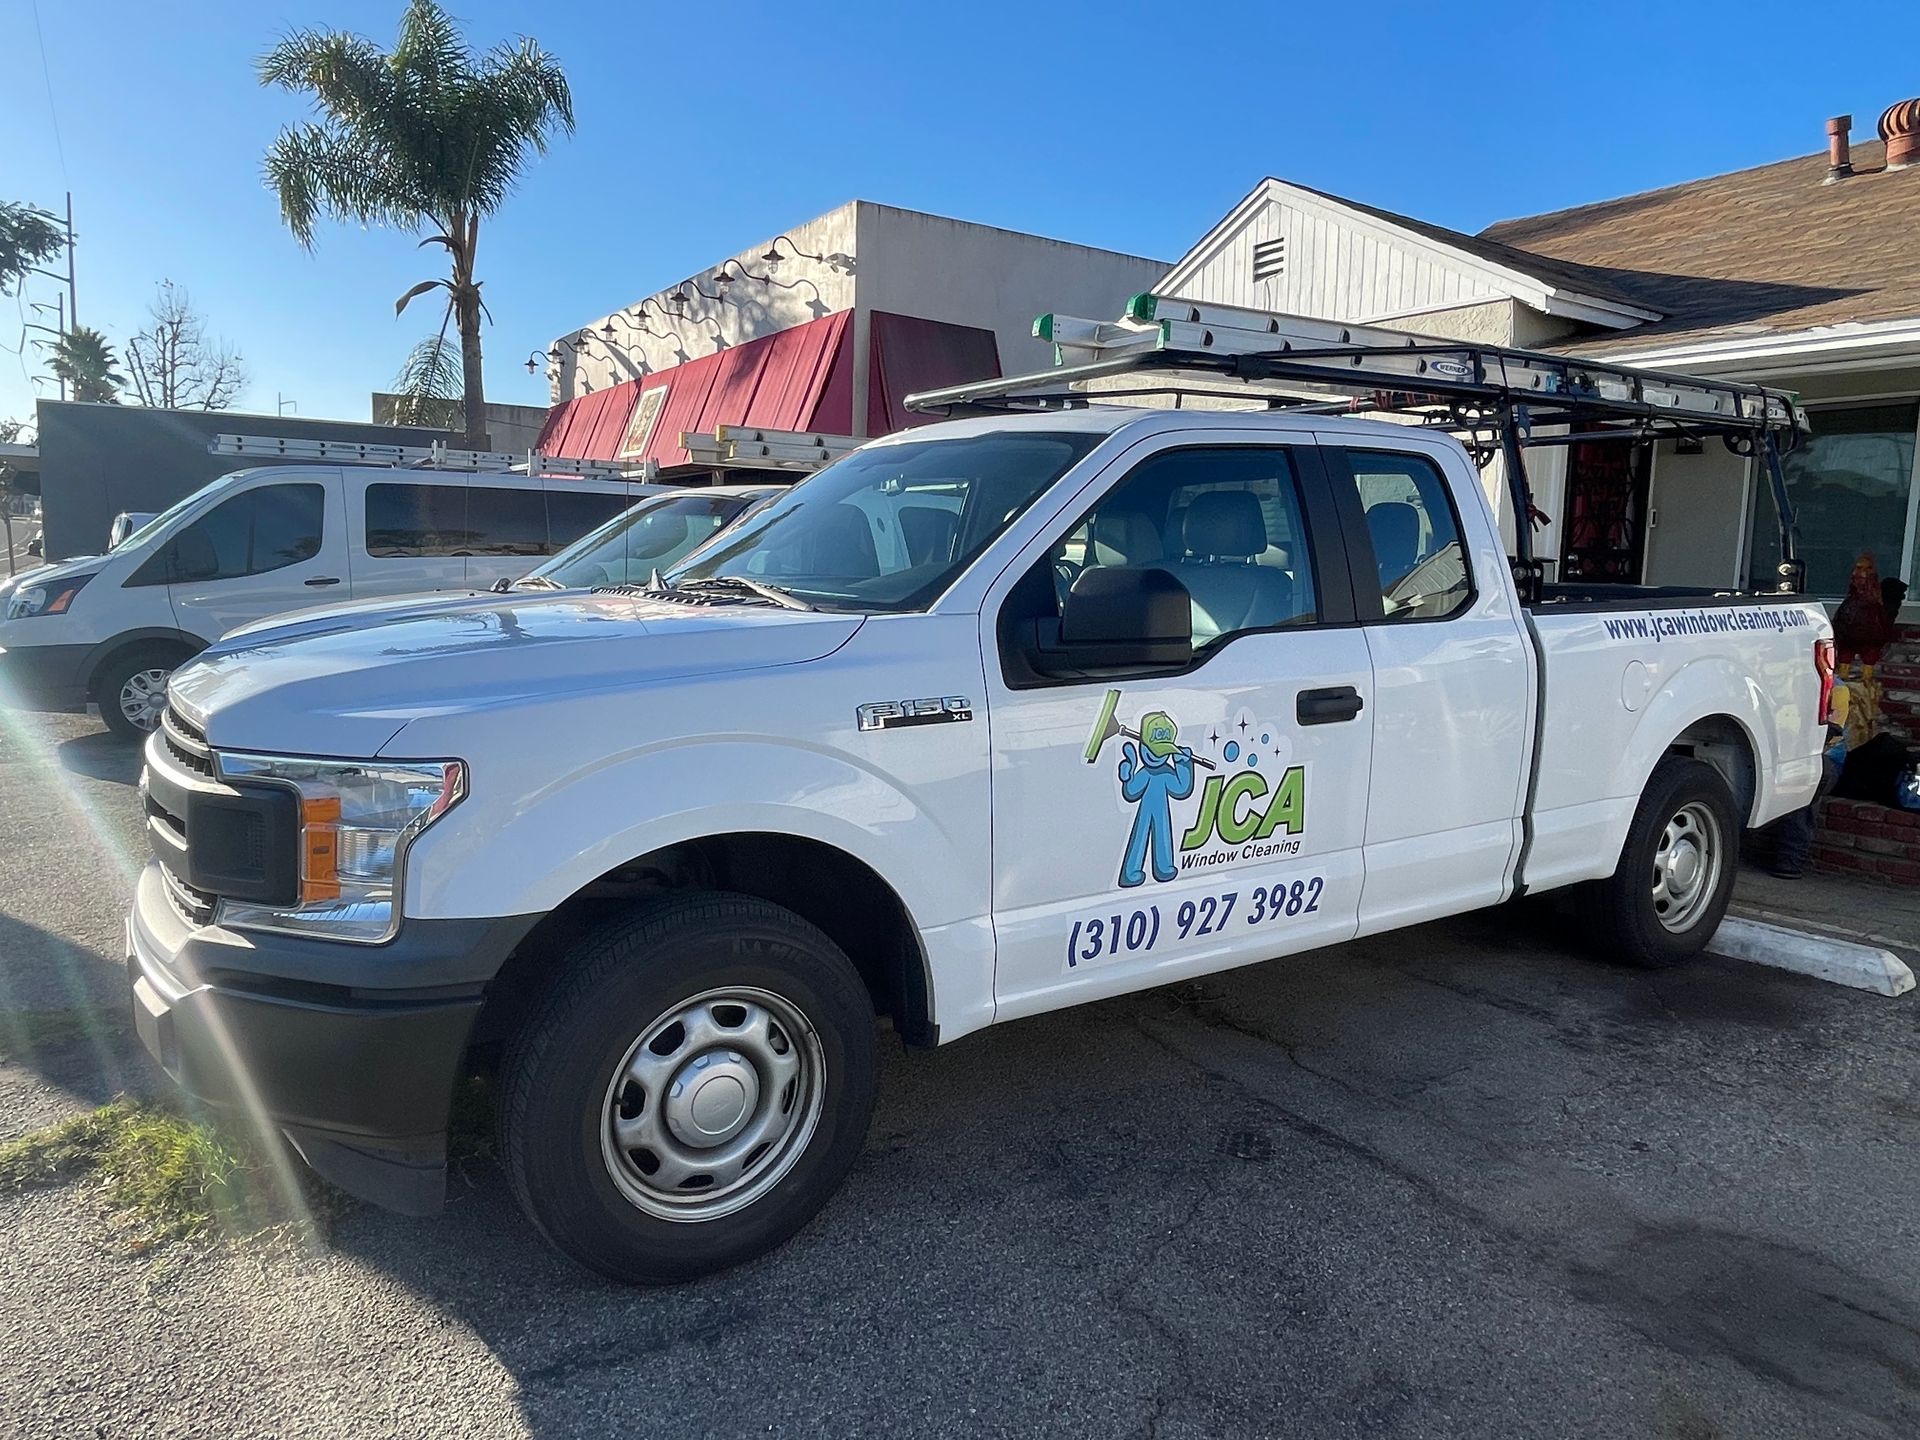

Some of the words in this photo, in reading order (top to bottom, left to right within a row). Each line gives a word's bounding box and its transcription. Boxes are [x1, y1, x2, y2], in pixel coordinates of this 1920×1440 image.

[1604, 607, 1809, 642] www.jcawindowcleaning.com
[1149, 727, 1171, 743] JCA
[1179, 765, 1305, 852] JCA
[1180, 850, 1239, 870] Window
[1242, 840, 1301, 859] Cleaning
[1067, 905, 1160, 967] (310)
[1177, 893, 1238, 939] 927
[1247, 877, 1324, 924] 3982
